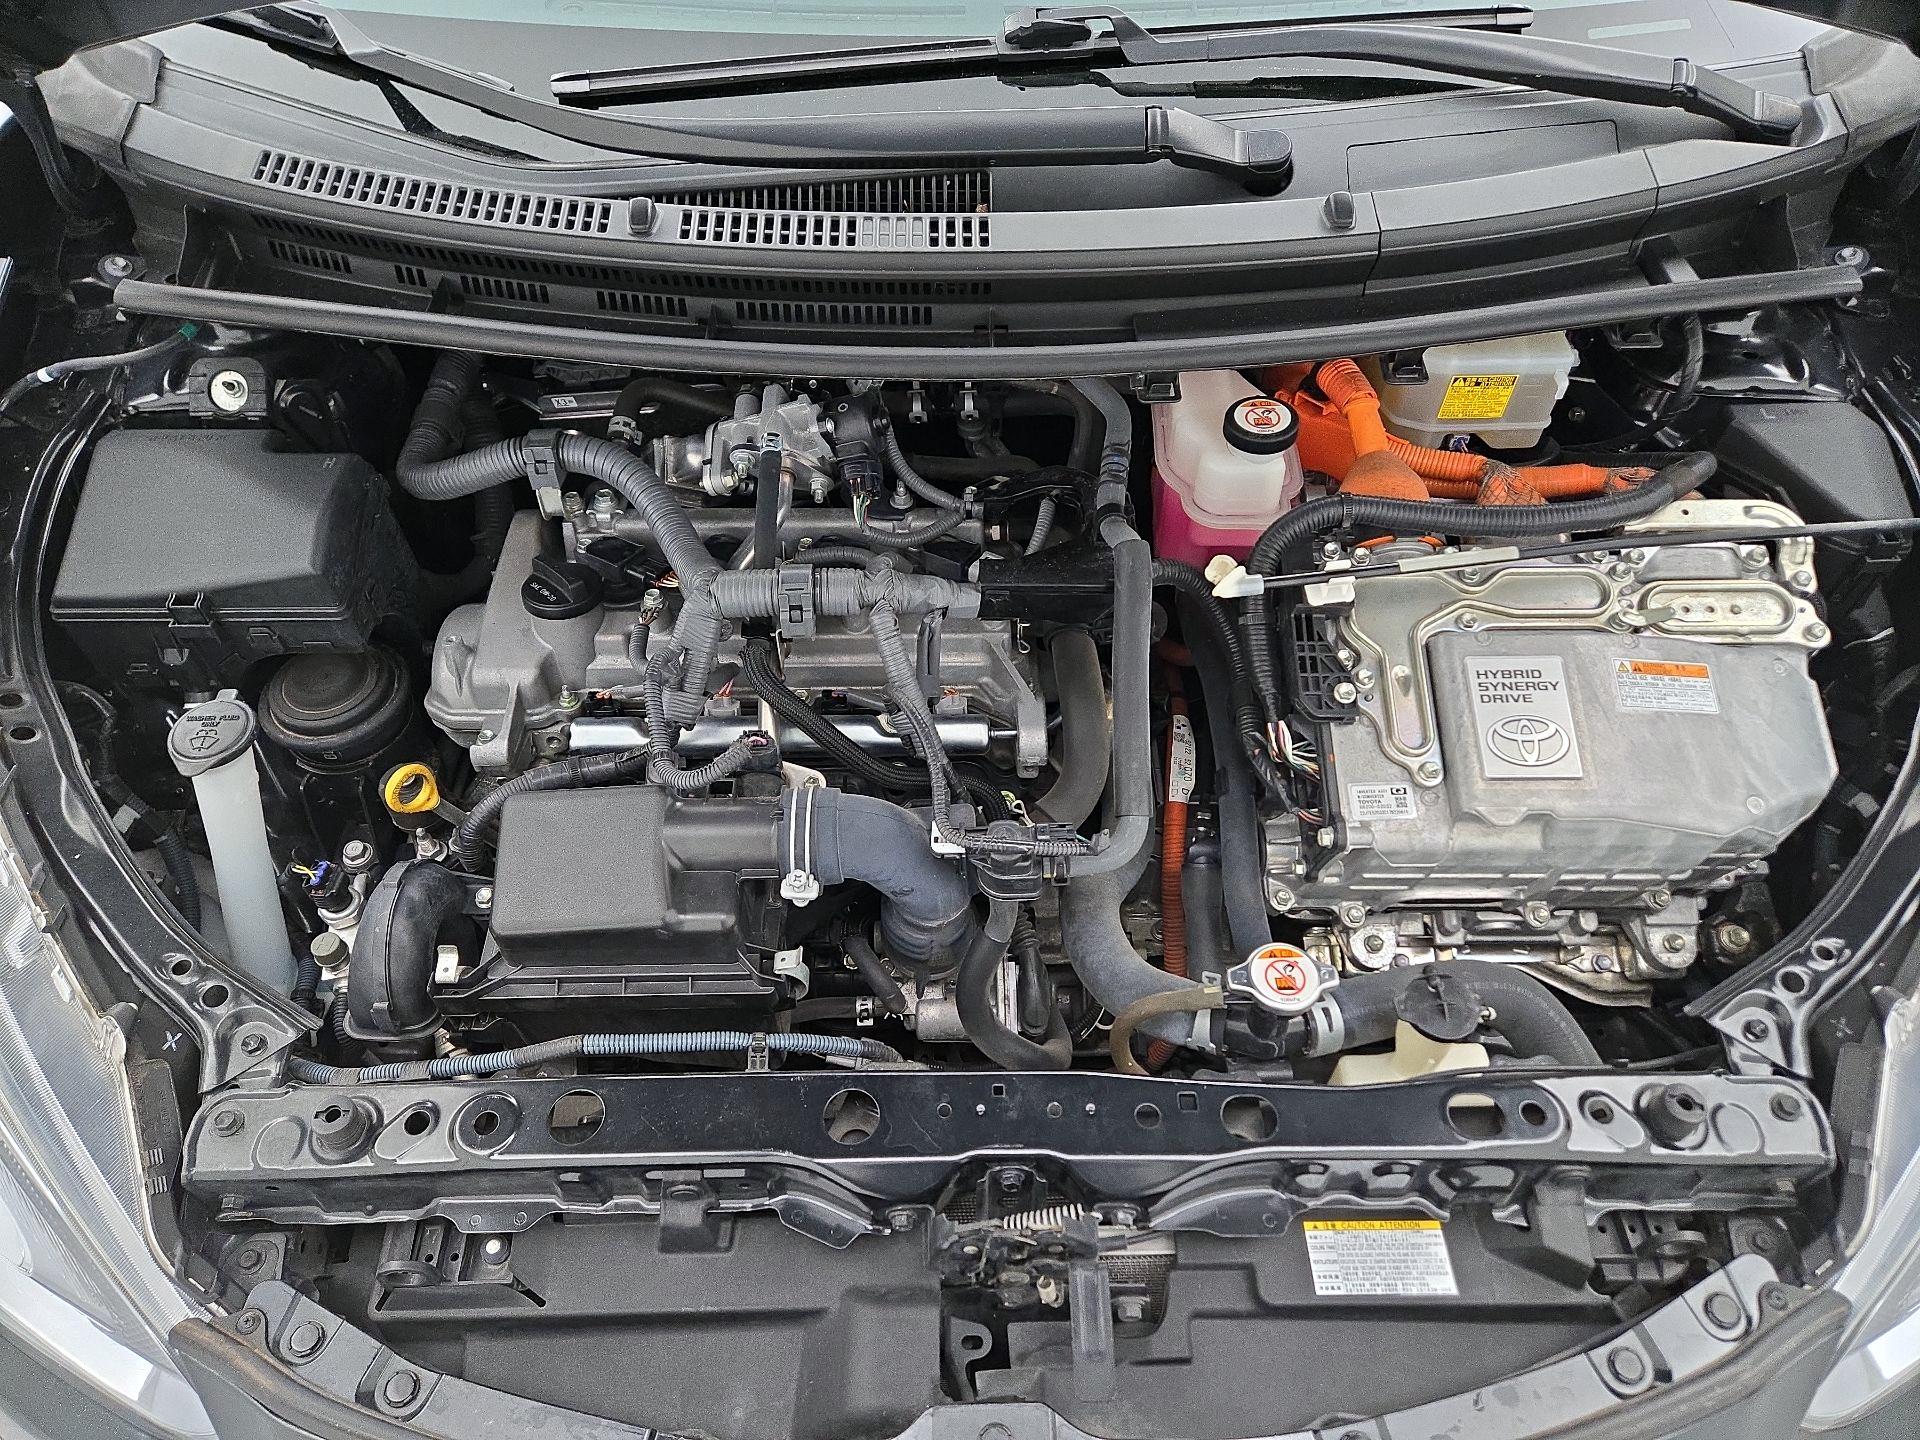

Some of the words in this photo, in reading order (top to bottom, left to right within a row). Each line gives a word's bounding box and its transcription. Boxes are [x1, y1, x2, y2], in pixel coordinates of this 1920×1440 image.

[529, 582, 543, 591] SAE
[1476, 669, 1542, 679] HYBRID
[1478, 681, 1559, 691] SYNERGY
[1480, 694, 1533, 703] DRIVE
[186, 714, 217, 722] WASHER
[1342, 1221, 1375, 1229] CAUTION
[1379, 1221, 1421, 1229] ATTENTION
